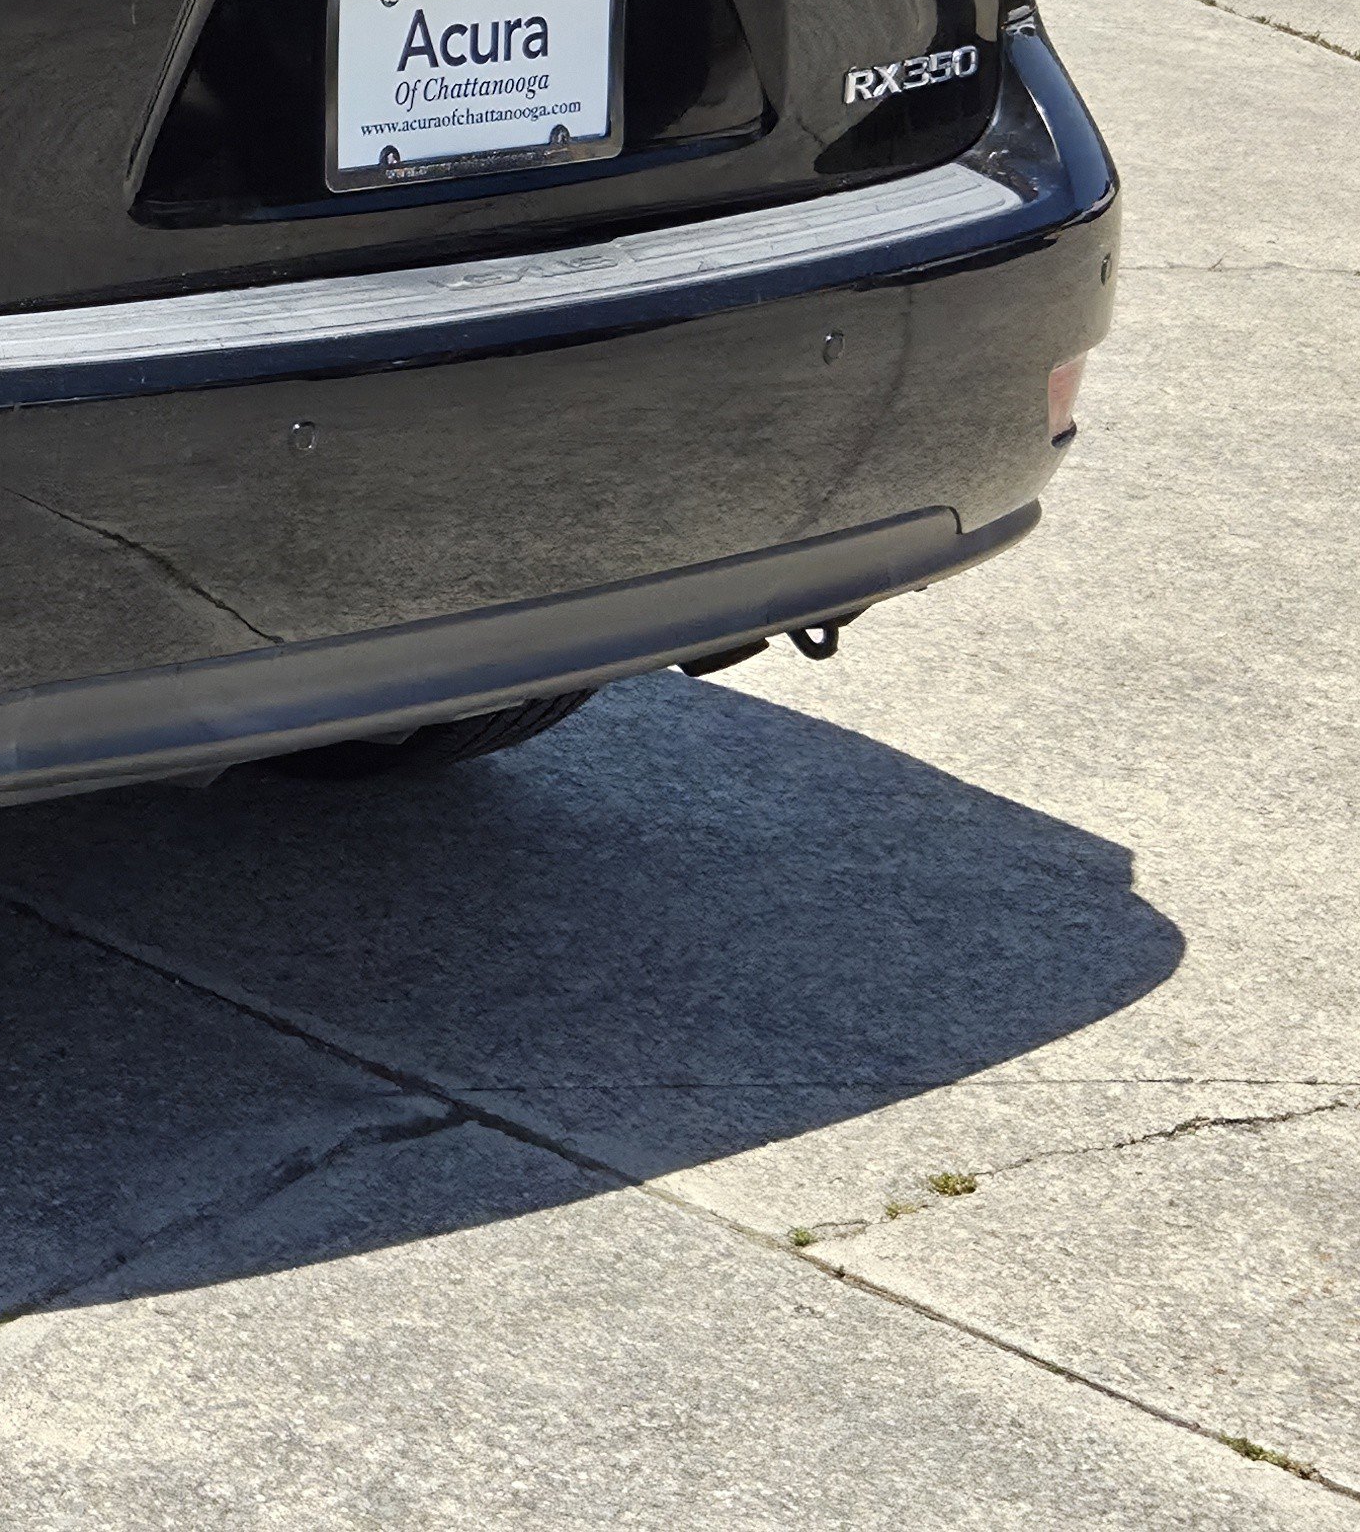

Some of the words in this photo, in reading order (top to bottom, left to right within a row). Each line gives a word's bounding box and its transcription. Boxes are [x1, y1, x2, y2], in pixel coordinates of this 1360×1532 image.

[397, 9, 548, 72] Acura
[395, 79, 421, 112] Of
[423, 74, 550, 101] Chattanooga
[843, 45, 978, 104] RX350
[360, 101, 582, 137] www.acuraofchattanooga.com
